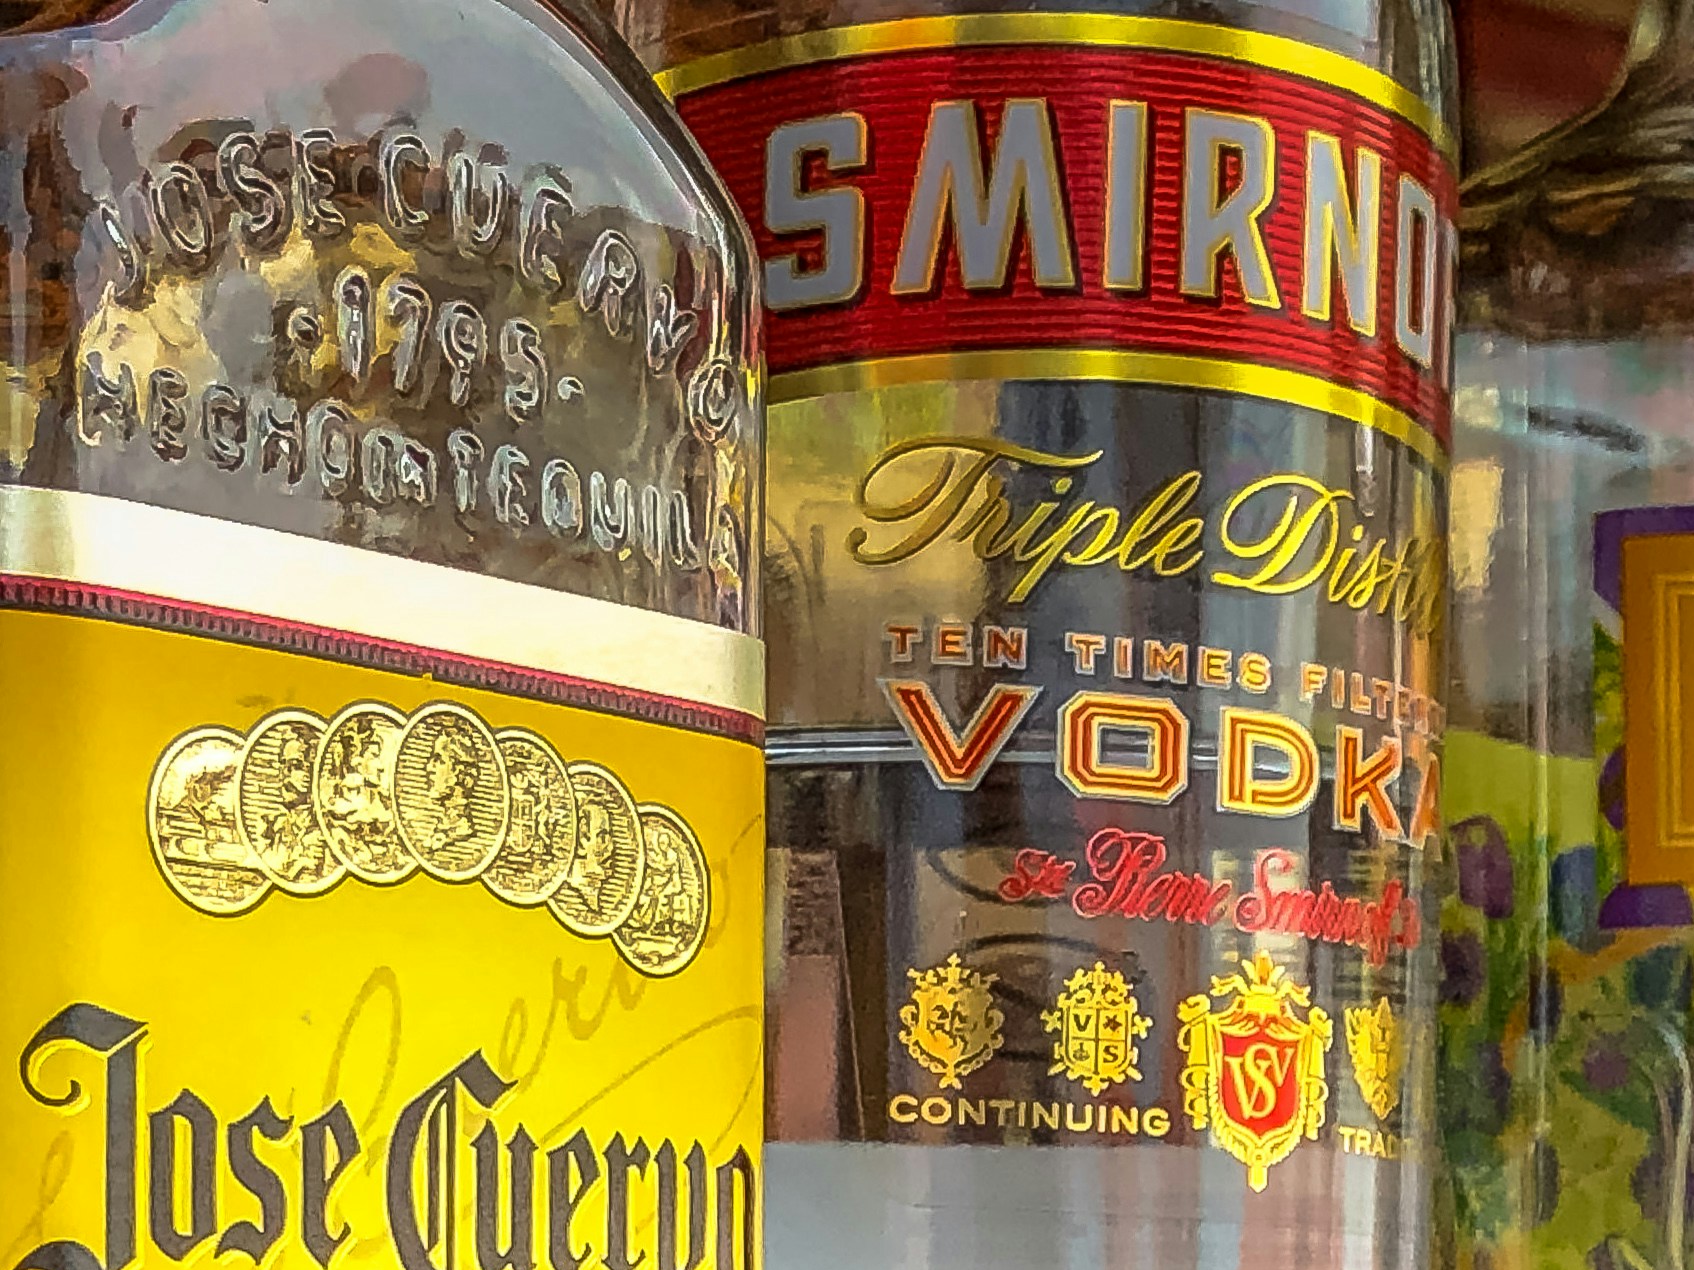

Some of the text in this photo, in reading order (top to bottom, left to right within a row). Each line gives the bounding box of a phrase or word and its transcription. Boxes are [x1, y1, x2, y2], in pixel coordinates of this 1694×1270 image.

[846, 437, 1206, 604] Triple
[884, 622, 1028, 670] TEN
[1065, 632, 1273, 694] TIMES
[889, 1094, 1172, 1138] CONTINUING
